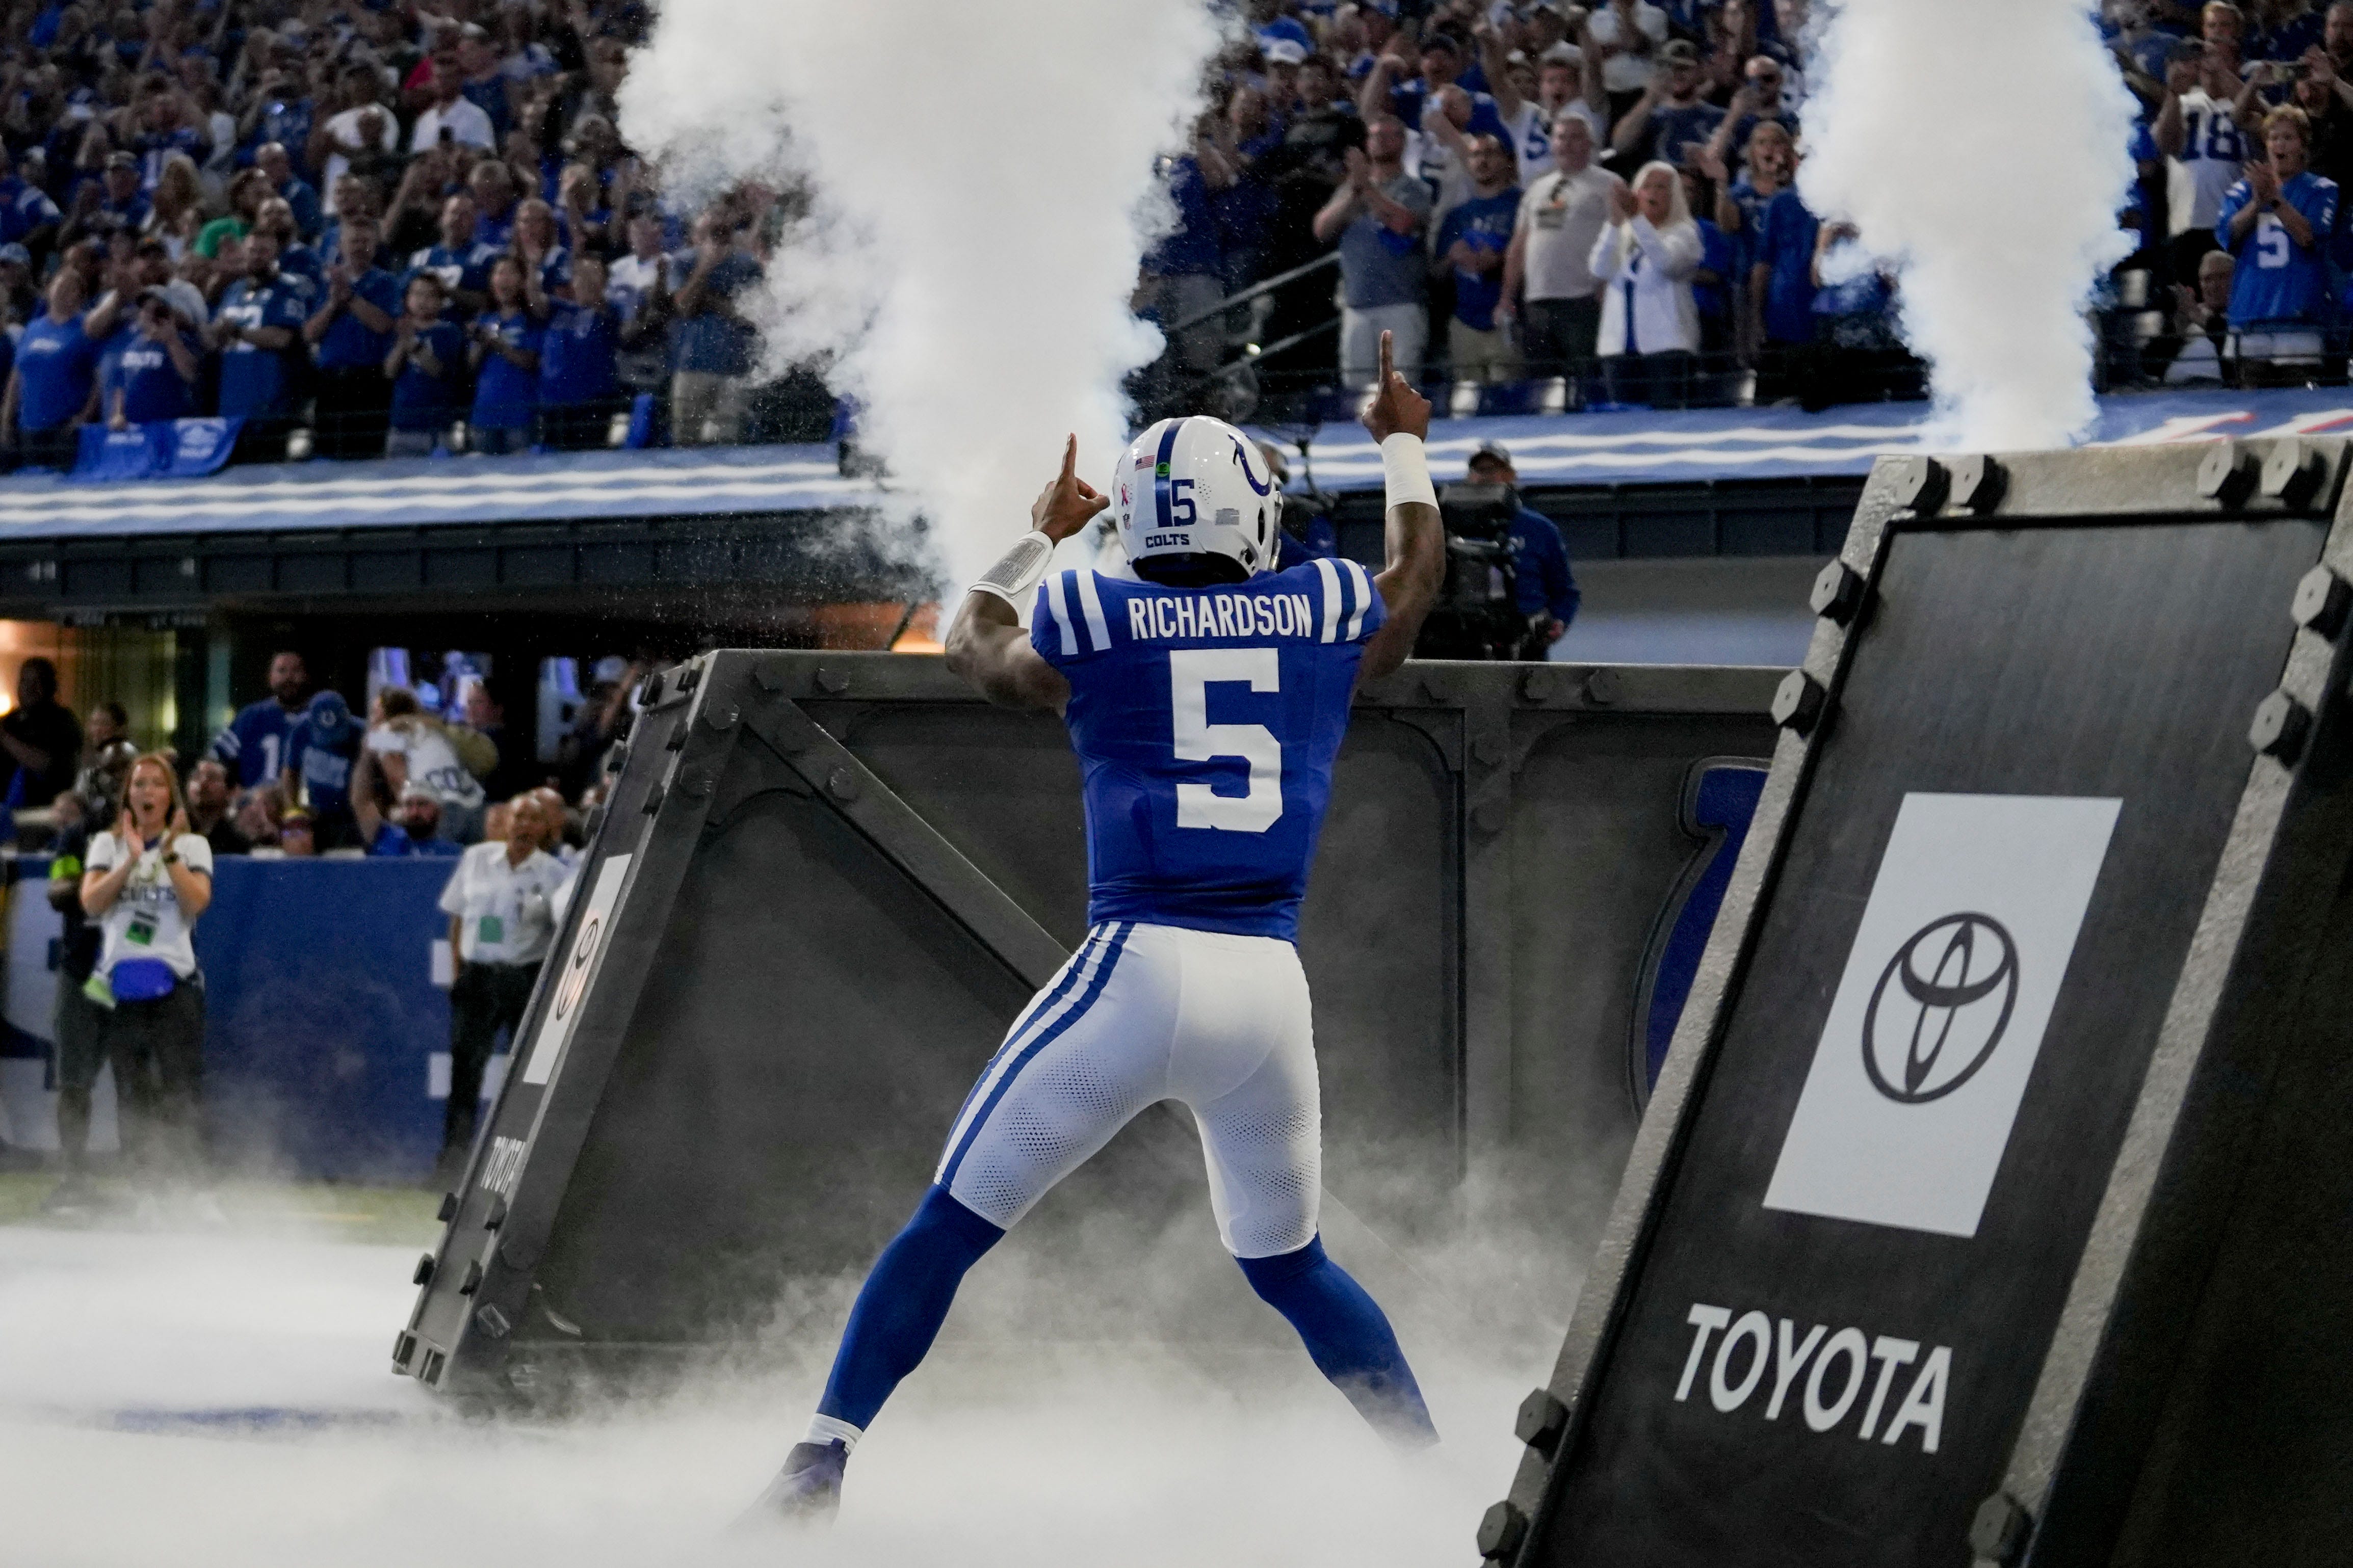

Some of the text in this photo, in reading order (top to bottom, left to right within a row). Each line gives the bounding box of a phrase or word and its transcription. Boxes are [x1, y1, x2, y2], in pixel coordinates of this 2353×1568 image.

[2182, 110, 2243, 160] 18
[2256, 211, 2290, 269] 5
[1171, 479, 1196, 526] 5
[1145, 533, 1190, 549] COLTS
[1128, 594, 1312, 640] RICHARDSON
[1170, 648, 1283, 833] 5
[1674, 1303, 1952, 1454] TOYOTA
